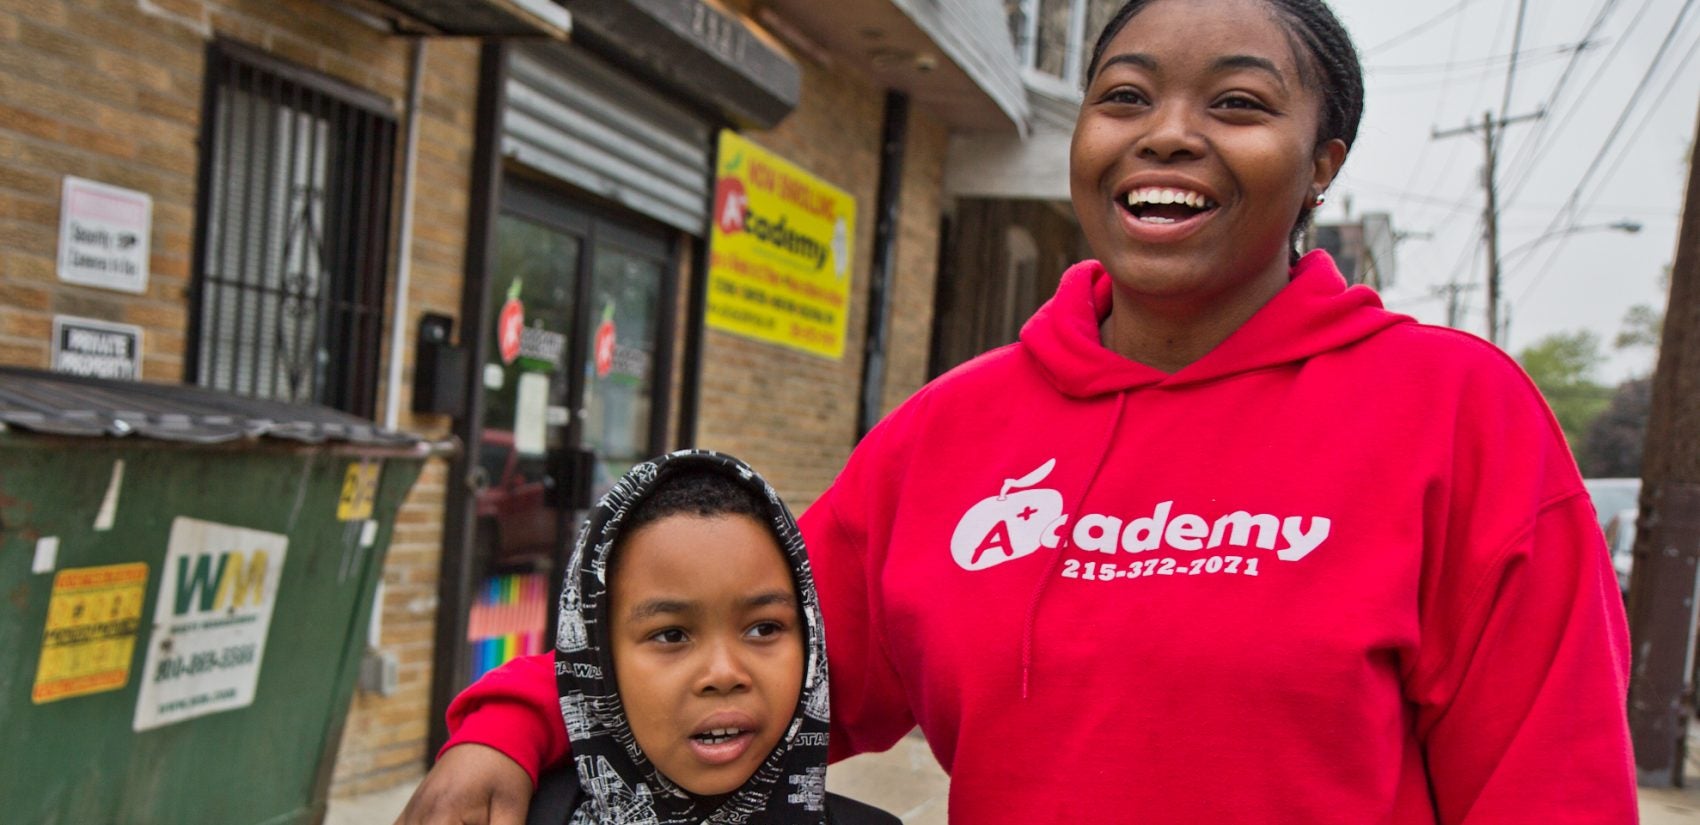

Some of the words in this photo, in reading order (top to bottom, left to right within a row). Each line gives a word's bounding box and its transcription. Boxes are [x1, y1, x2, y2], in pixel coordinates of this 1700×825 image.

[67, 327, 130, 358] PRIVATE
[173, 550, 269, 616] WM
[1061, 555, 1260, 583] 215-372-7071
